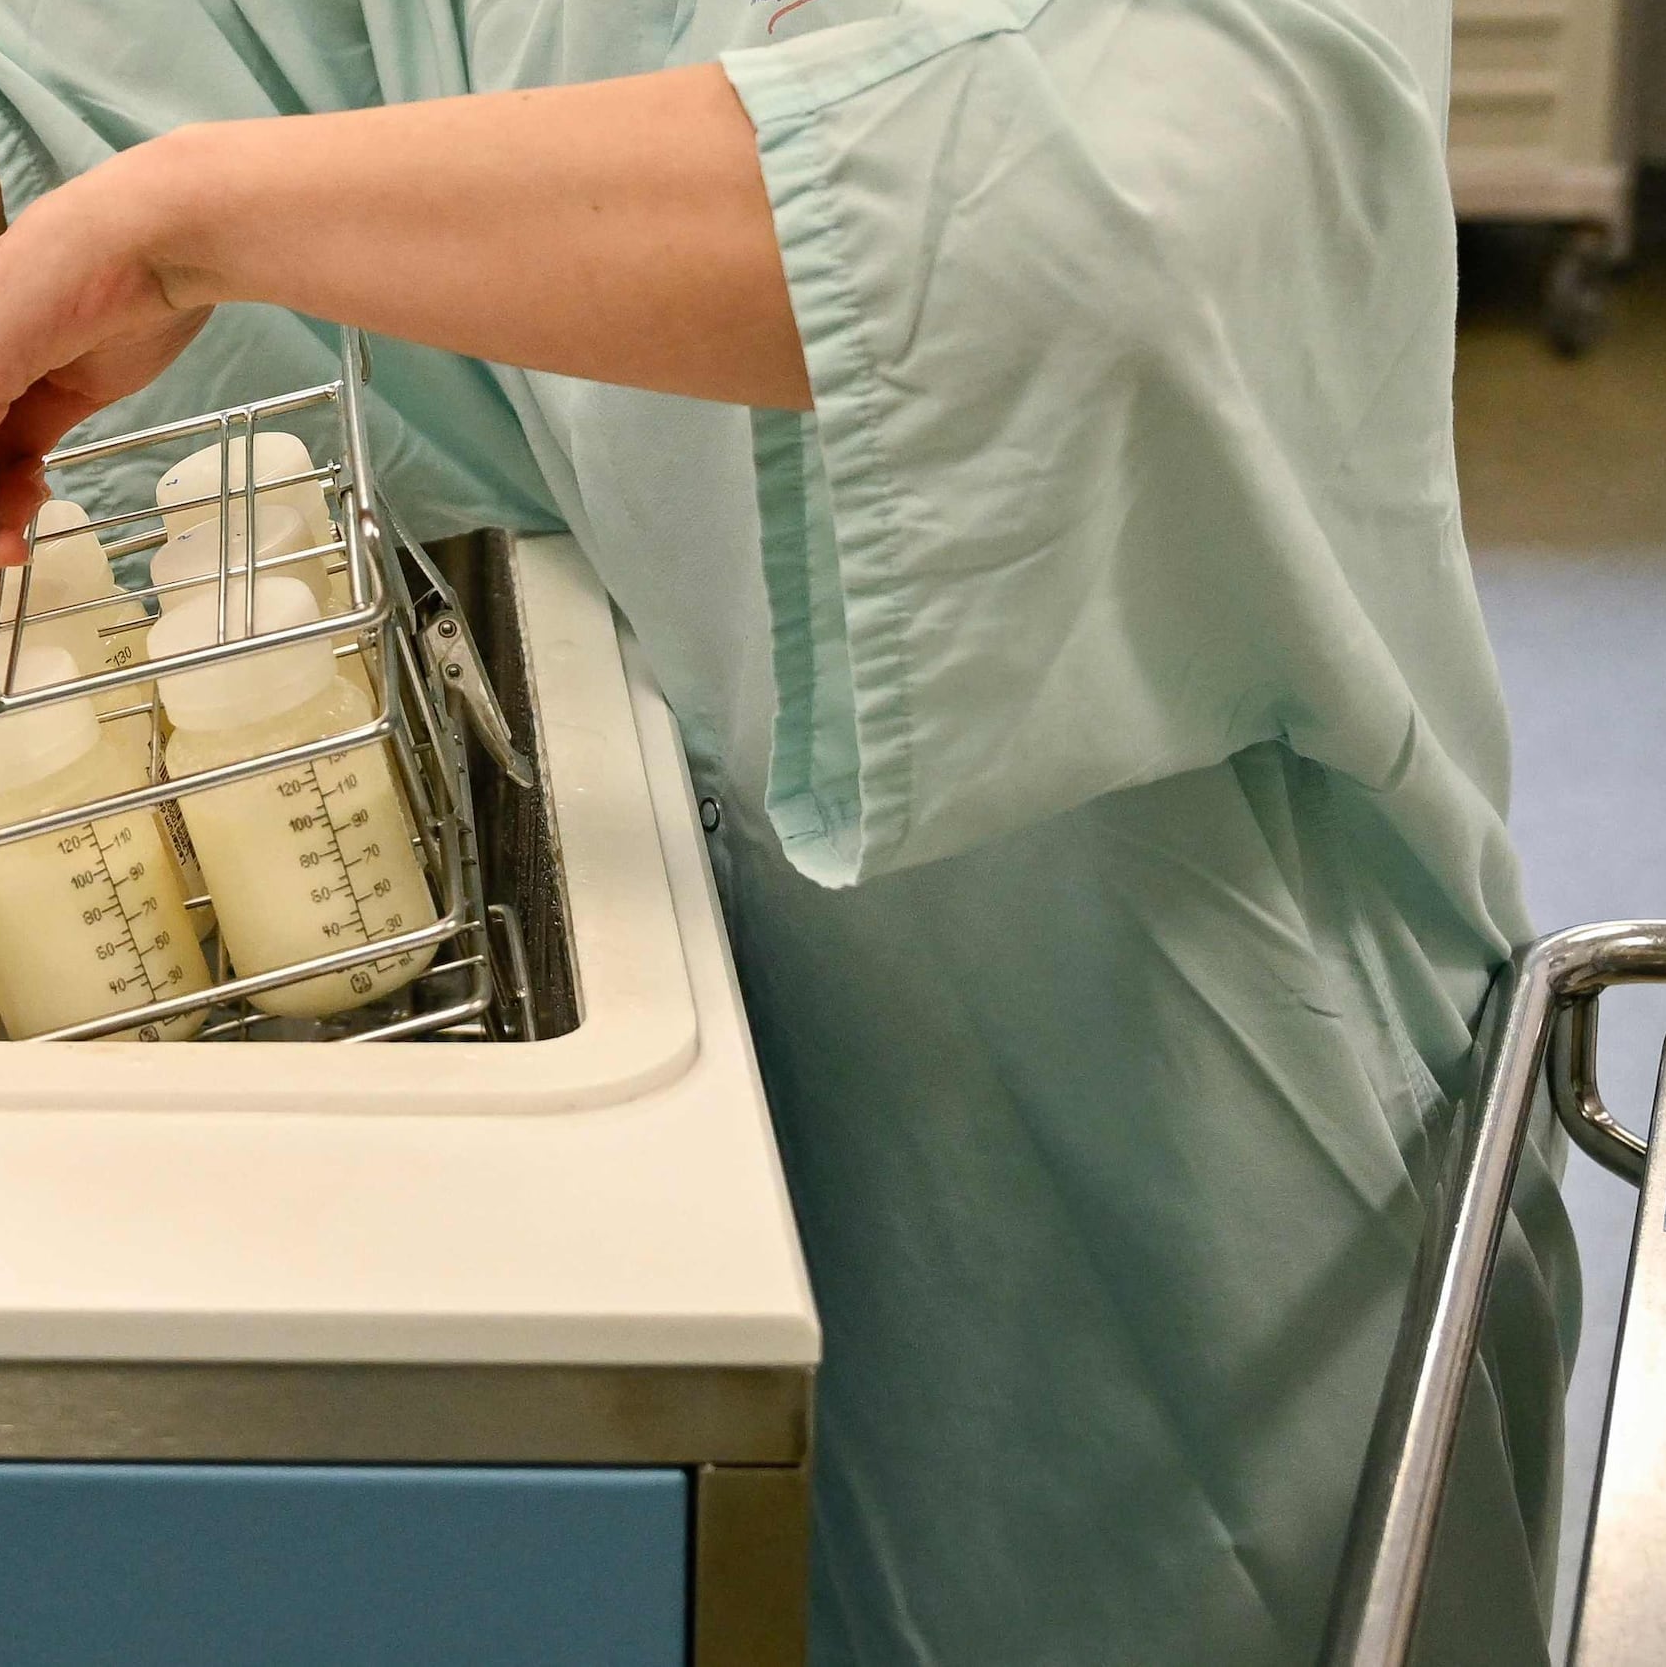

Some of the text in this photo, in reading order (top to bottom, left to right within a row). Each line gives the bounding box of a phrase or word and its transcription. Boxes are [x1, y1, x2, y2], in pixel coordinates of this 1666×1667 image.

[113, 645, 132, 666] 130
[276, 780, 302, 797] 120
[337, 774, 357, 794] 110
[289, 815, 314, 833] 100
[349, 809, 368, 827] 90
[57, 835, 81, 855] 120
[113, 827, 132, 848] 110
[300, 852, 320, 869] 80
[363, 844, 380, 863] 70
[71, 869, 95, 890] 100
[129, 862, 145, 881] 90
[311, 886, 332, 903] 60
[374, 878, 391, 897] 50
[83, 907, 102, 925] 80
[142, 896, 158, 917] 70
[322, 922, 340, 937] 40
[386, 914, 403, 932] 30
[154, 930, 170, 951] 50
[96, 941, 115, 960] 60
[167, 965, 183, 984] 30
[109, 977, 126, 996] 40
